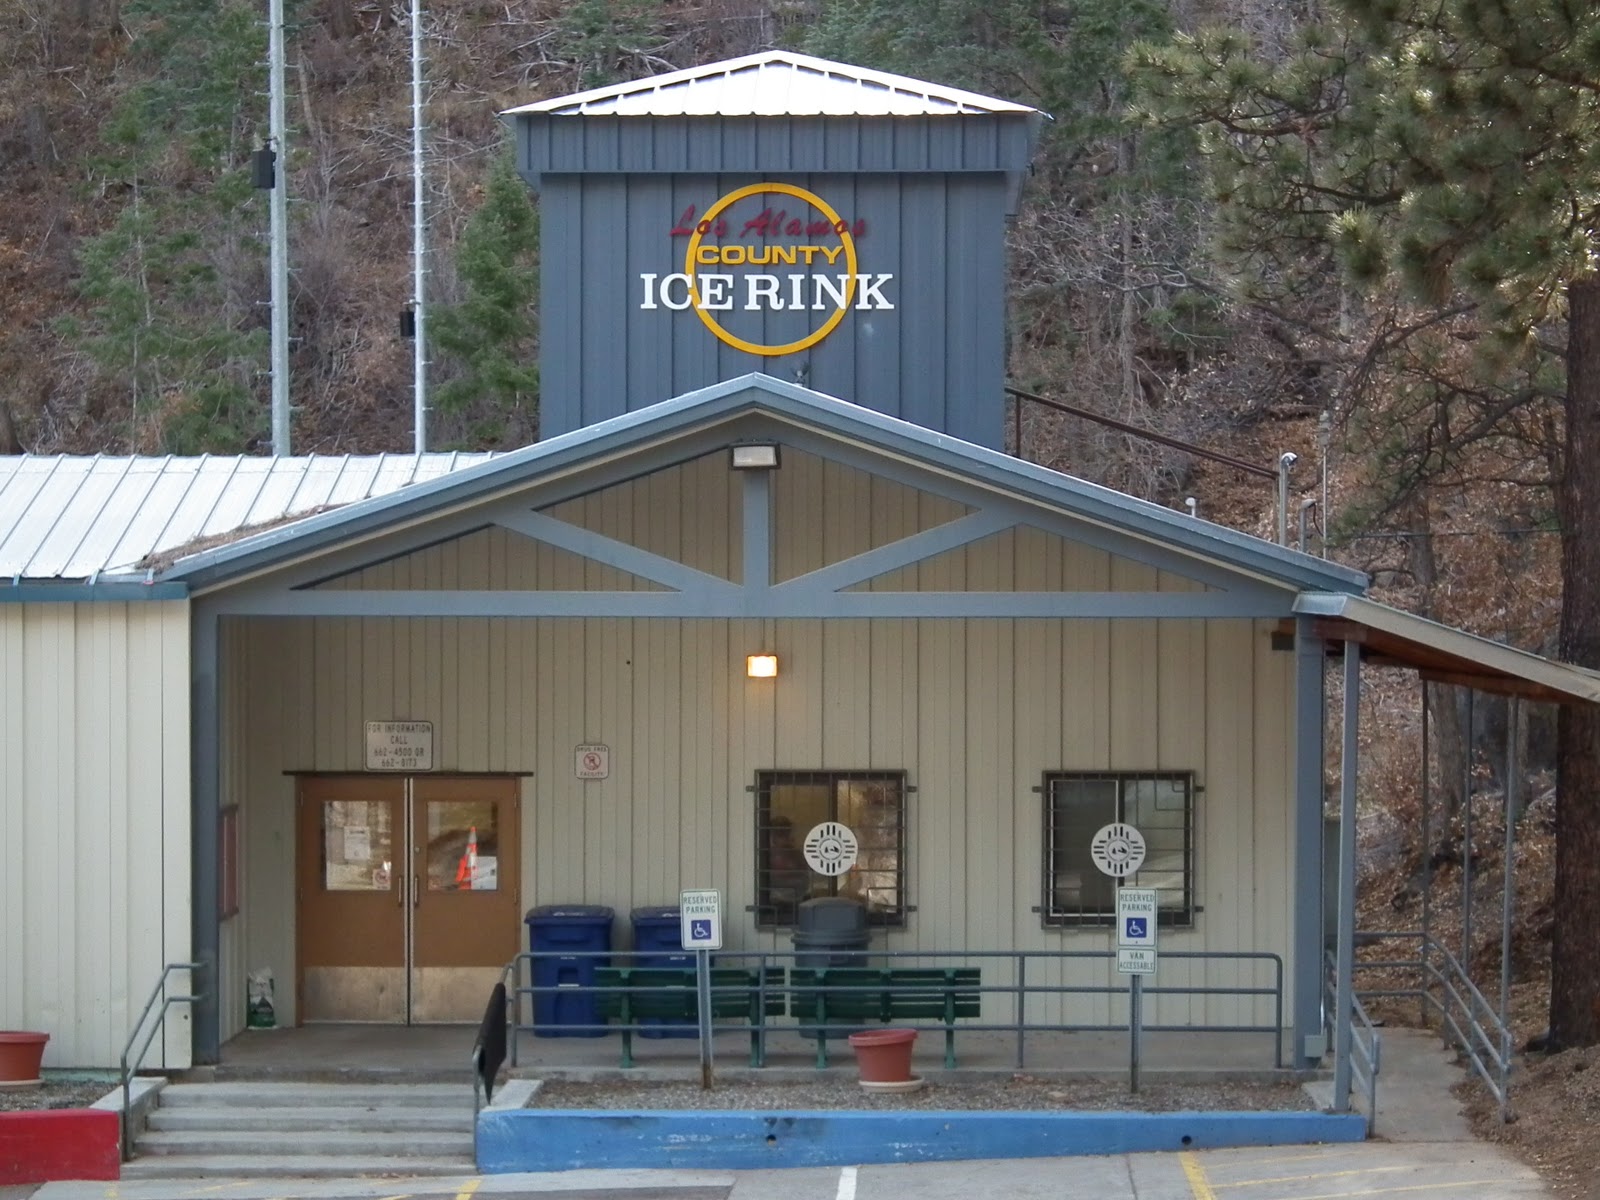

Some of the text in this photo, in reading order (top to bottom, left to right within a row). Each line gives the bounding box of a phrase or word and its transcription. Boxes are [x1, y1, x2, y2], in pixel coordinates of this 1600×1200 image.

[669, 203, 867, 238] Los Alamos
[696, 245, 844, 264] COUNTY
[640, 273, 895, 310] ICE RINK
[368, 724, 431, 733] FOR INFORMATION
[391, 735, 408, 745] CALL
[414, 747, 425, 757] OR
[683, 896, 717, 904] RESERVED
[1121, 893, 1155, 902] RESERVED
[686, 905, 716, 914] PARKING
[1122, 903, 1152, 912] PARKING
[1130, 951, 1145, 960] VAN
